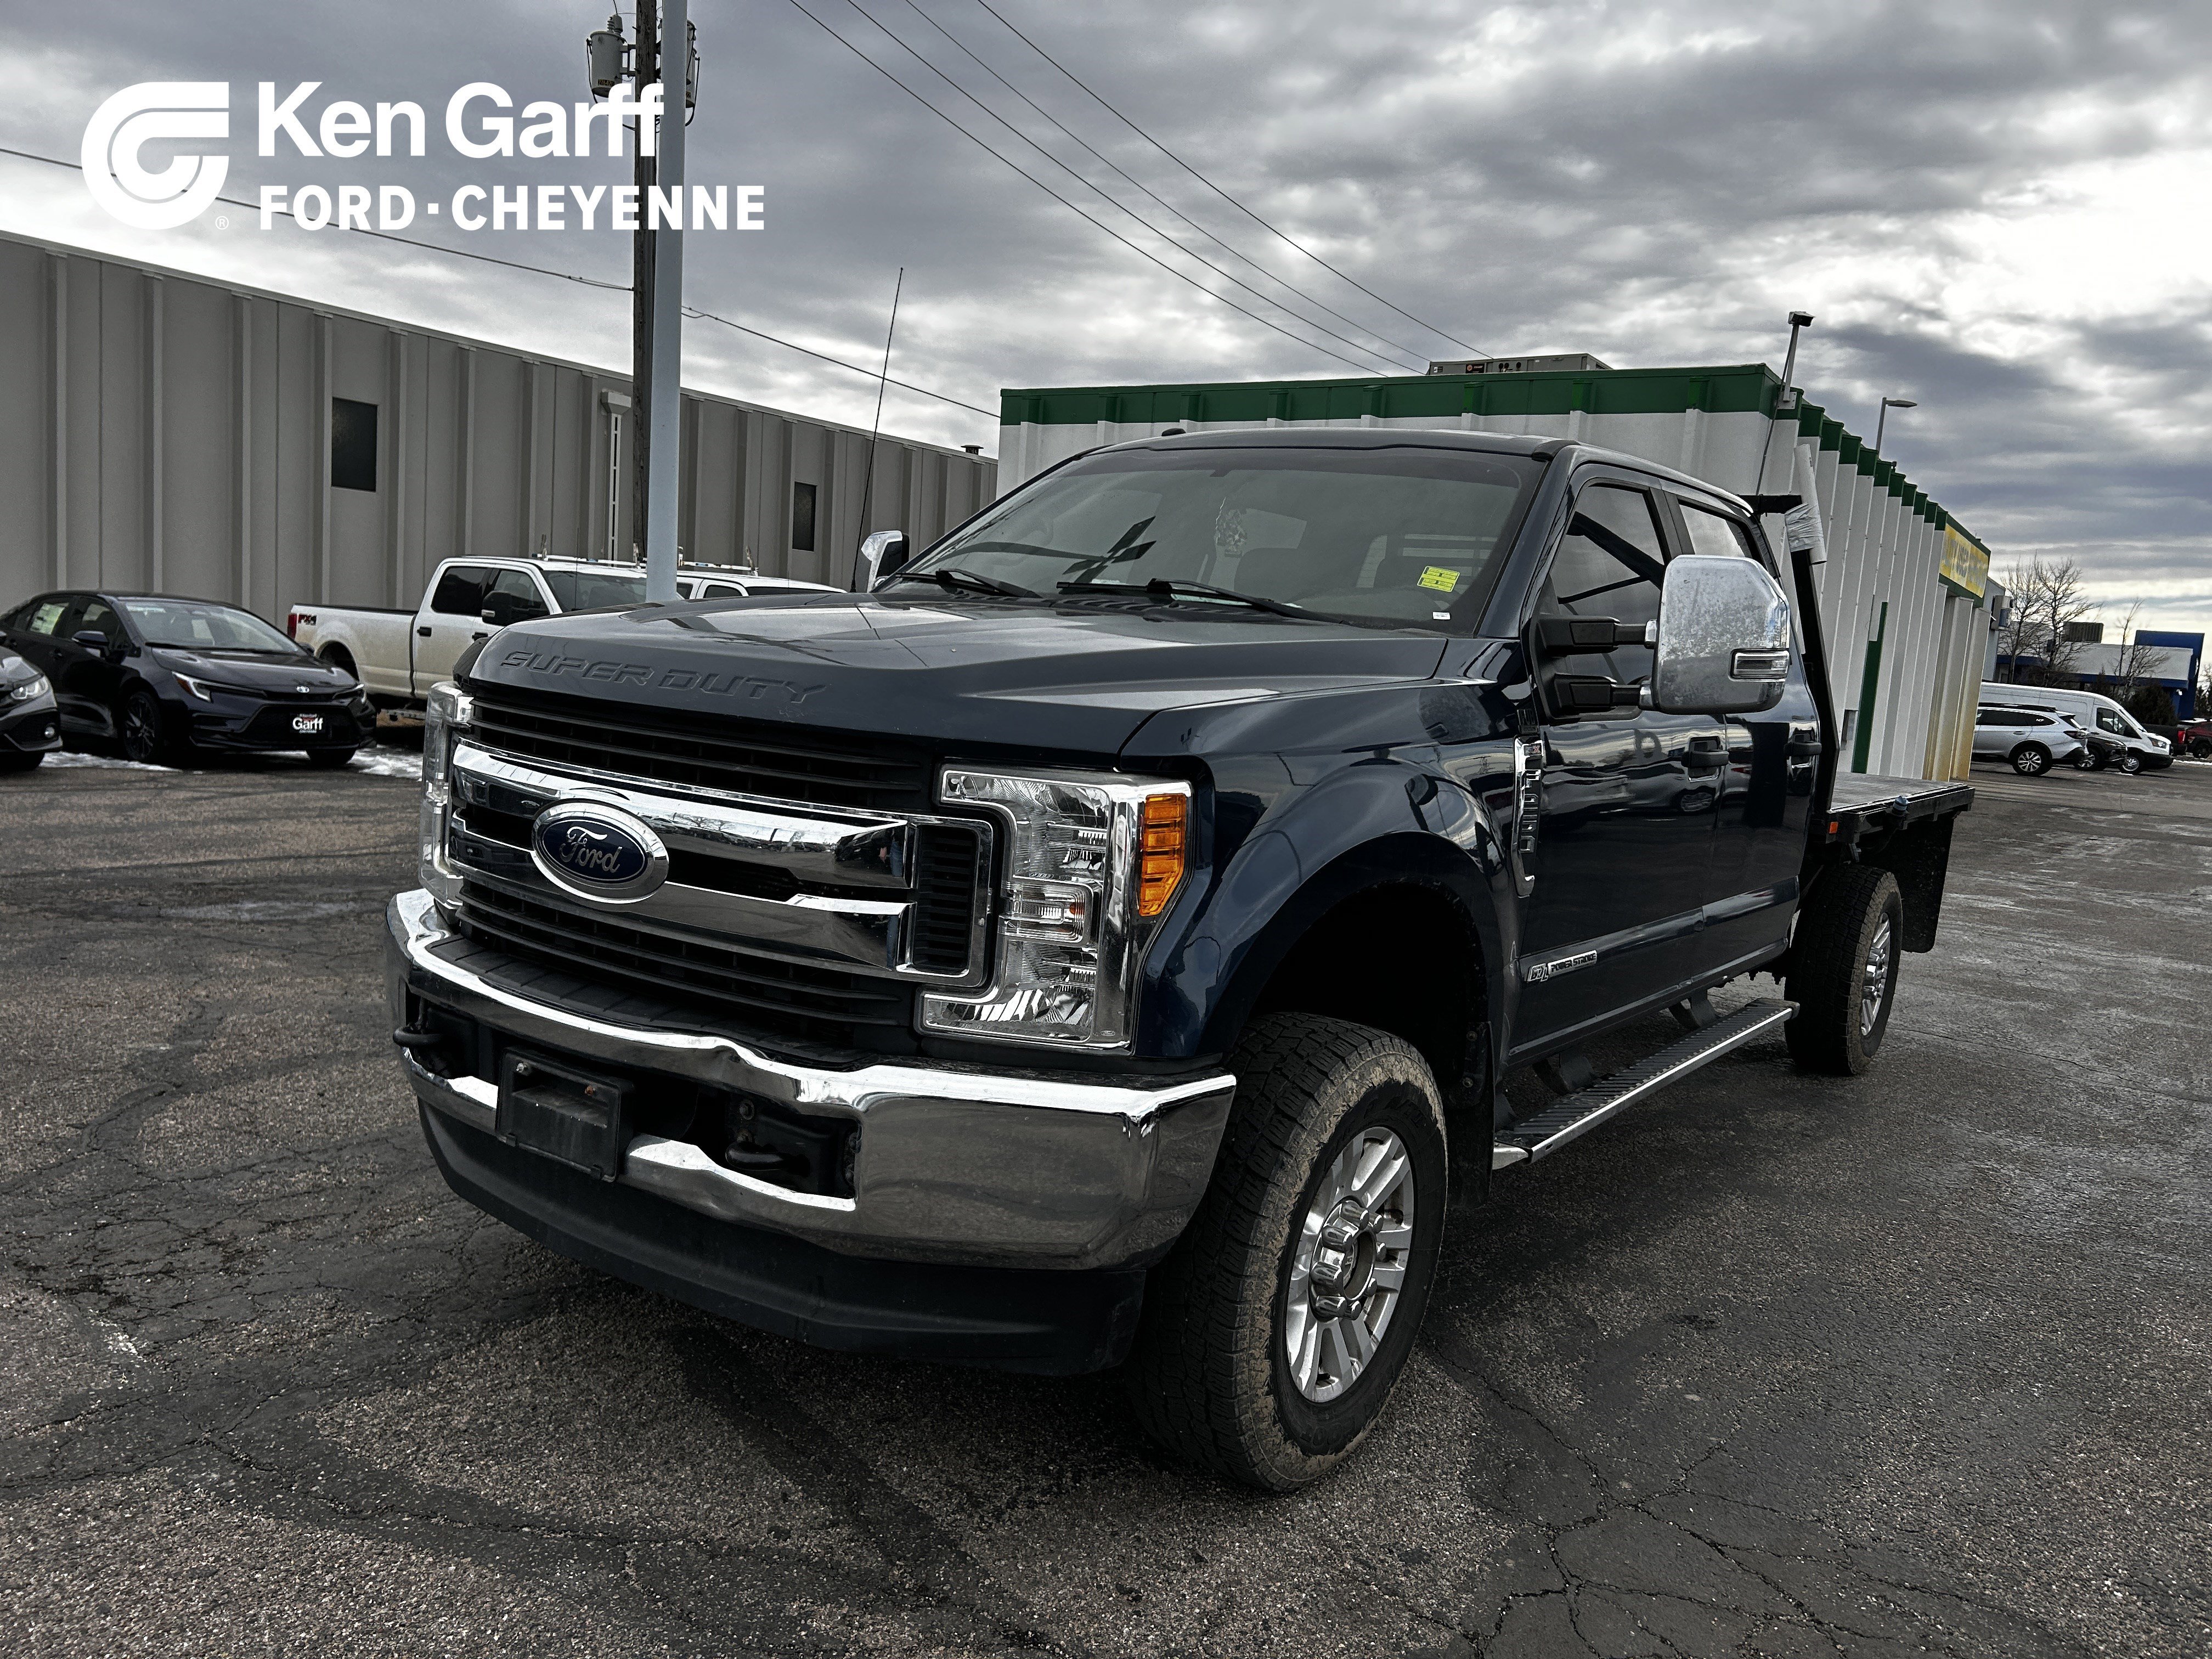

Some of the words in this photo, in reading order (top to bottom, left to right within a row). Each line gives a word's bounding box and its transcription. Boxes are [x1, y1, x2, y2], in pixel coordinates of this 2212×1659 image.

[500, 651, 656, 686] SUPER
[657, 668, 827, 704] DUTY
[292, 716, 323, 730] Garff
[560, 826, 622, 874] Ford
